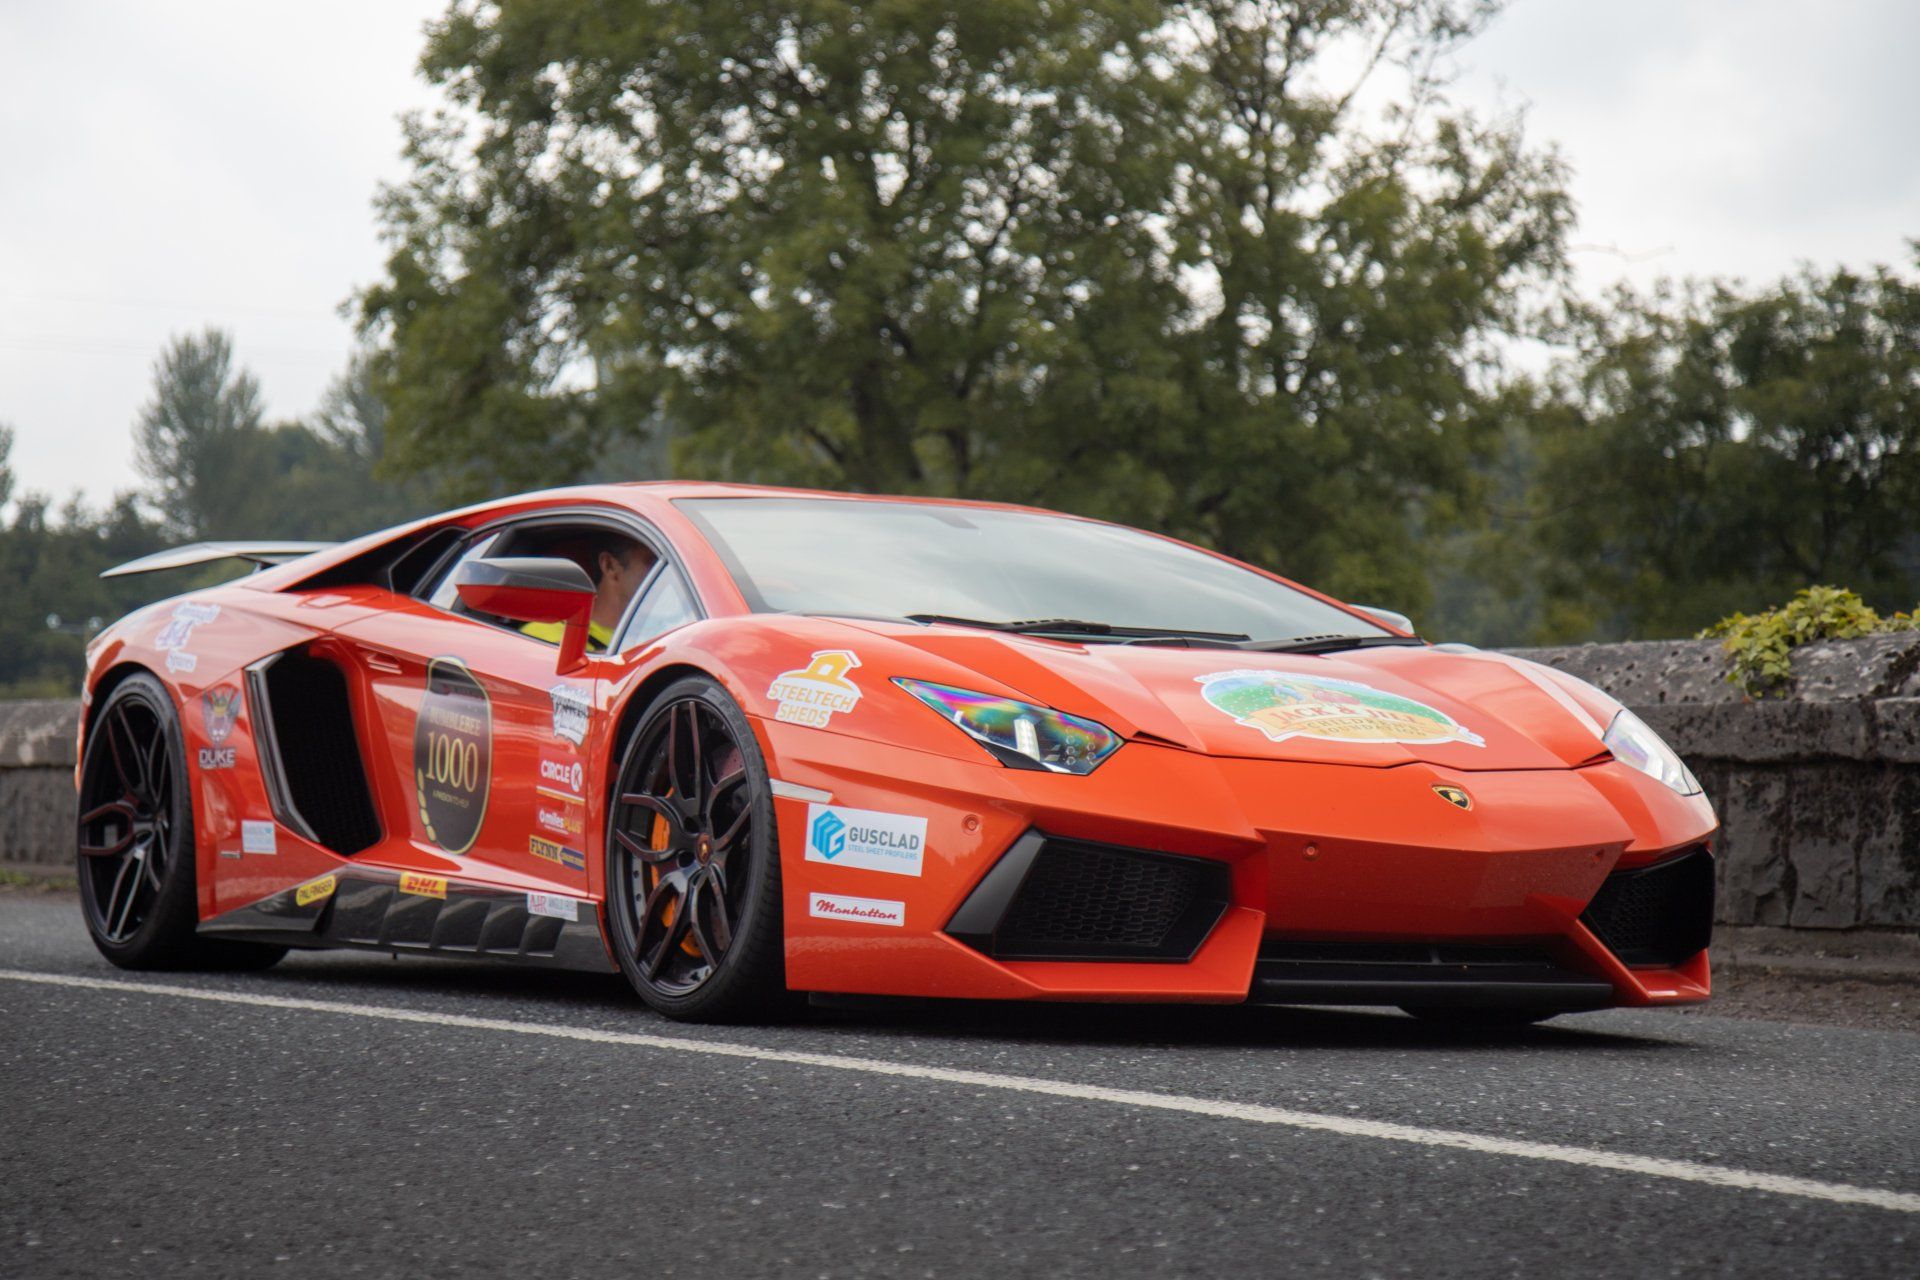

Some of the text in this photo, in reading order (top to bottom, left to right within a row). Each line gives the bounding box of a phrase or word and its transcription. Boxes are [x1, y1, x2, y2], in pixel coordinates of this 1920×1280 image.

[769, 682, 852, 710] STEELTECH
[777, 703, 828, 726] SHEDS
[199, 748, 236, 764] DUKE
[425, 731, 479, 793] 1000
[540, 760, 570, 784] CIRCLE
[531, 839, 558, 861] FLYNN
[849, 826, 919, 851] GUSCLAD
[406, 876, 439, 894] DHL
[815, 899, 898, 920] Manhattan
